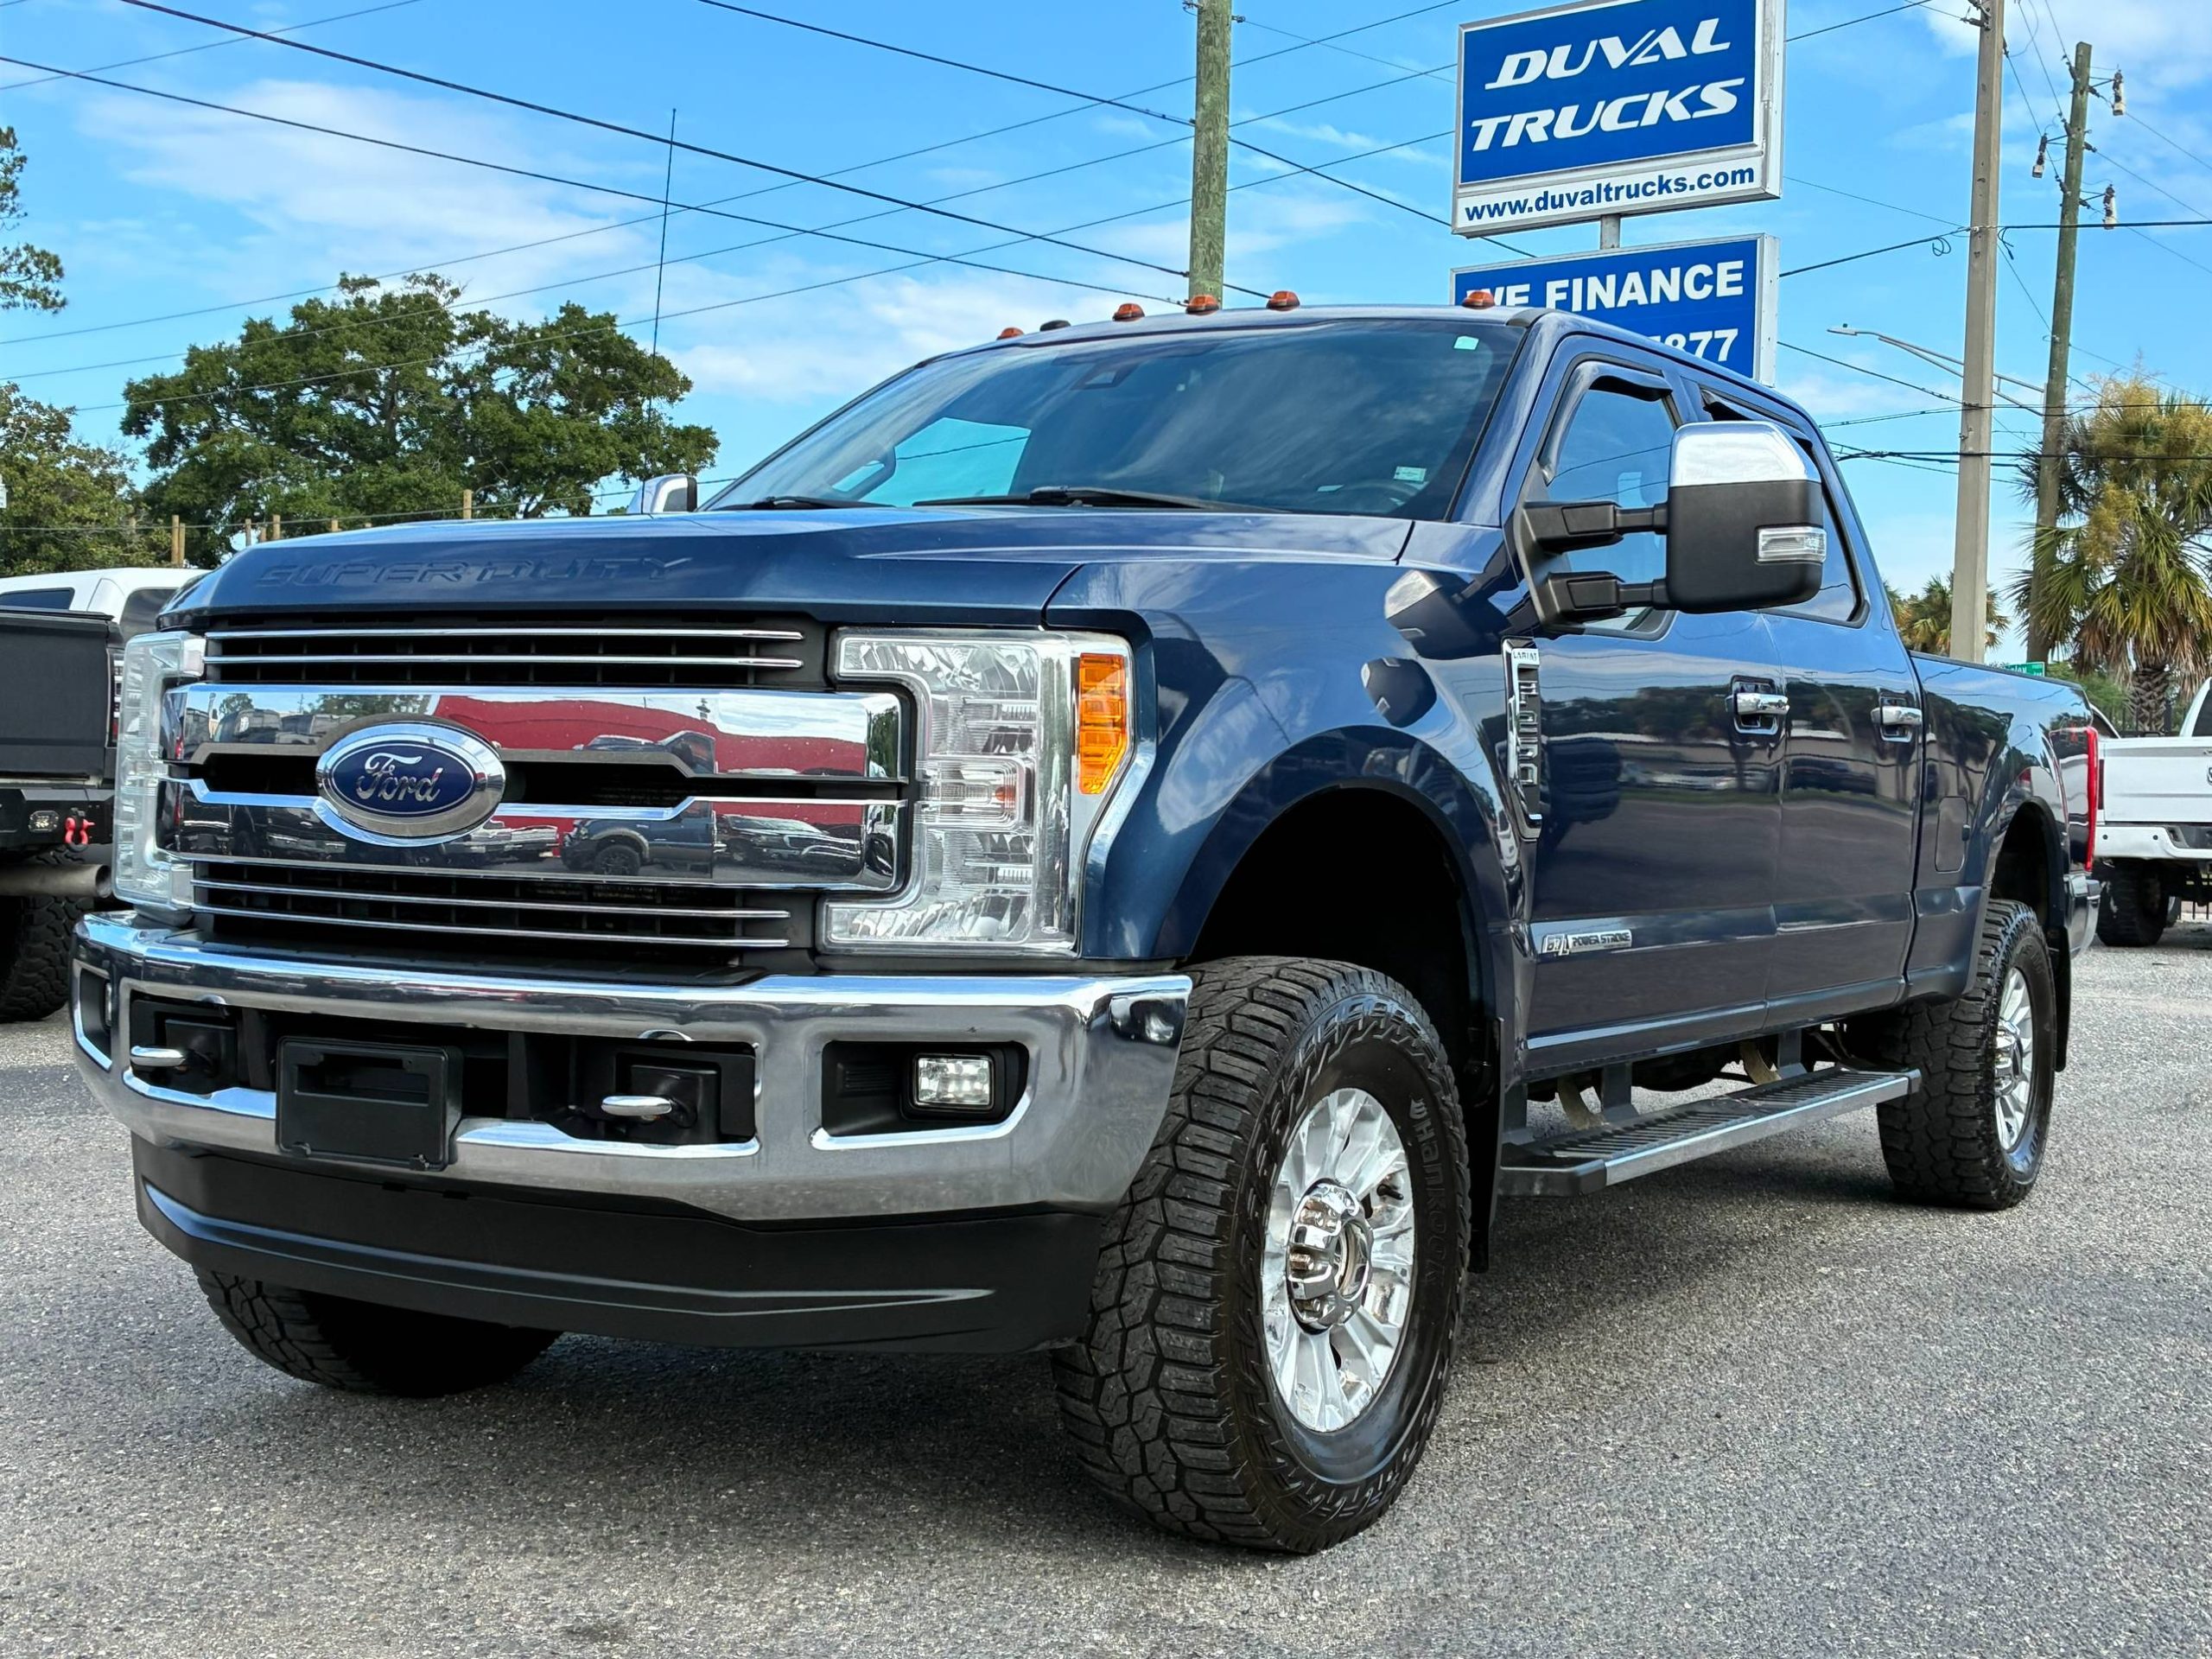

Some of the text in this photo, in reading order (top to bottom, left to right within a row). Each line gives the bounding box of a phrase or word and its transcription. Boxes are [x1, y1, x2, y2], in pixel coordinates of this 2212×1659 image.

[1484, 17, 1731, 90] DUVAL
[1471, 77, 1745, 152] TRUCKS
[1465, 167, 1754, 221] www.duvaltrucks.com
[1546, 260, 1744, 311] FINANCE
[256, 556, 693, 588] SUPER DUTY
[1512, 651, 1537, 662] LARIAT
[356, 753, 443, 802] Ford
[1572, 935, 1600, 948] POWER
[1600, 932, 1630, 944] STROKE
